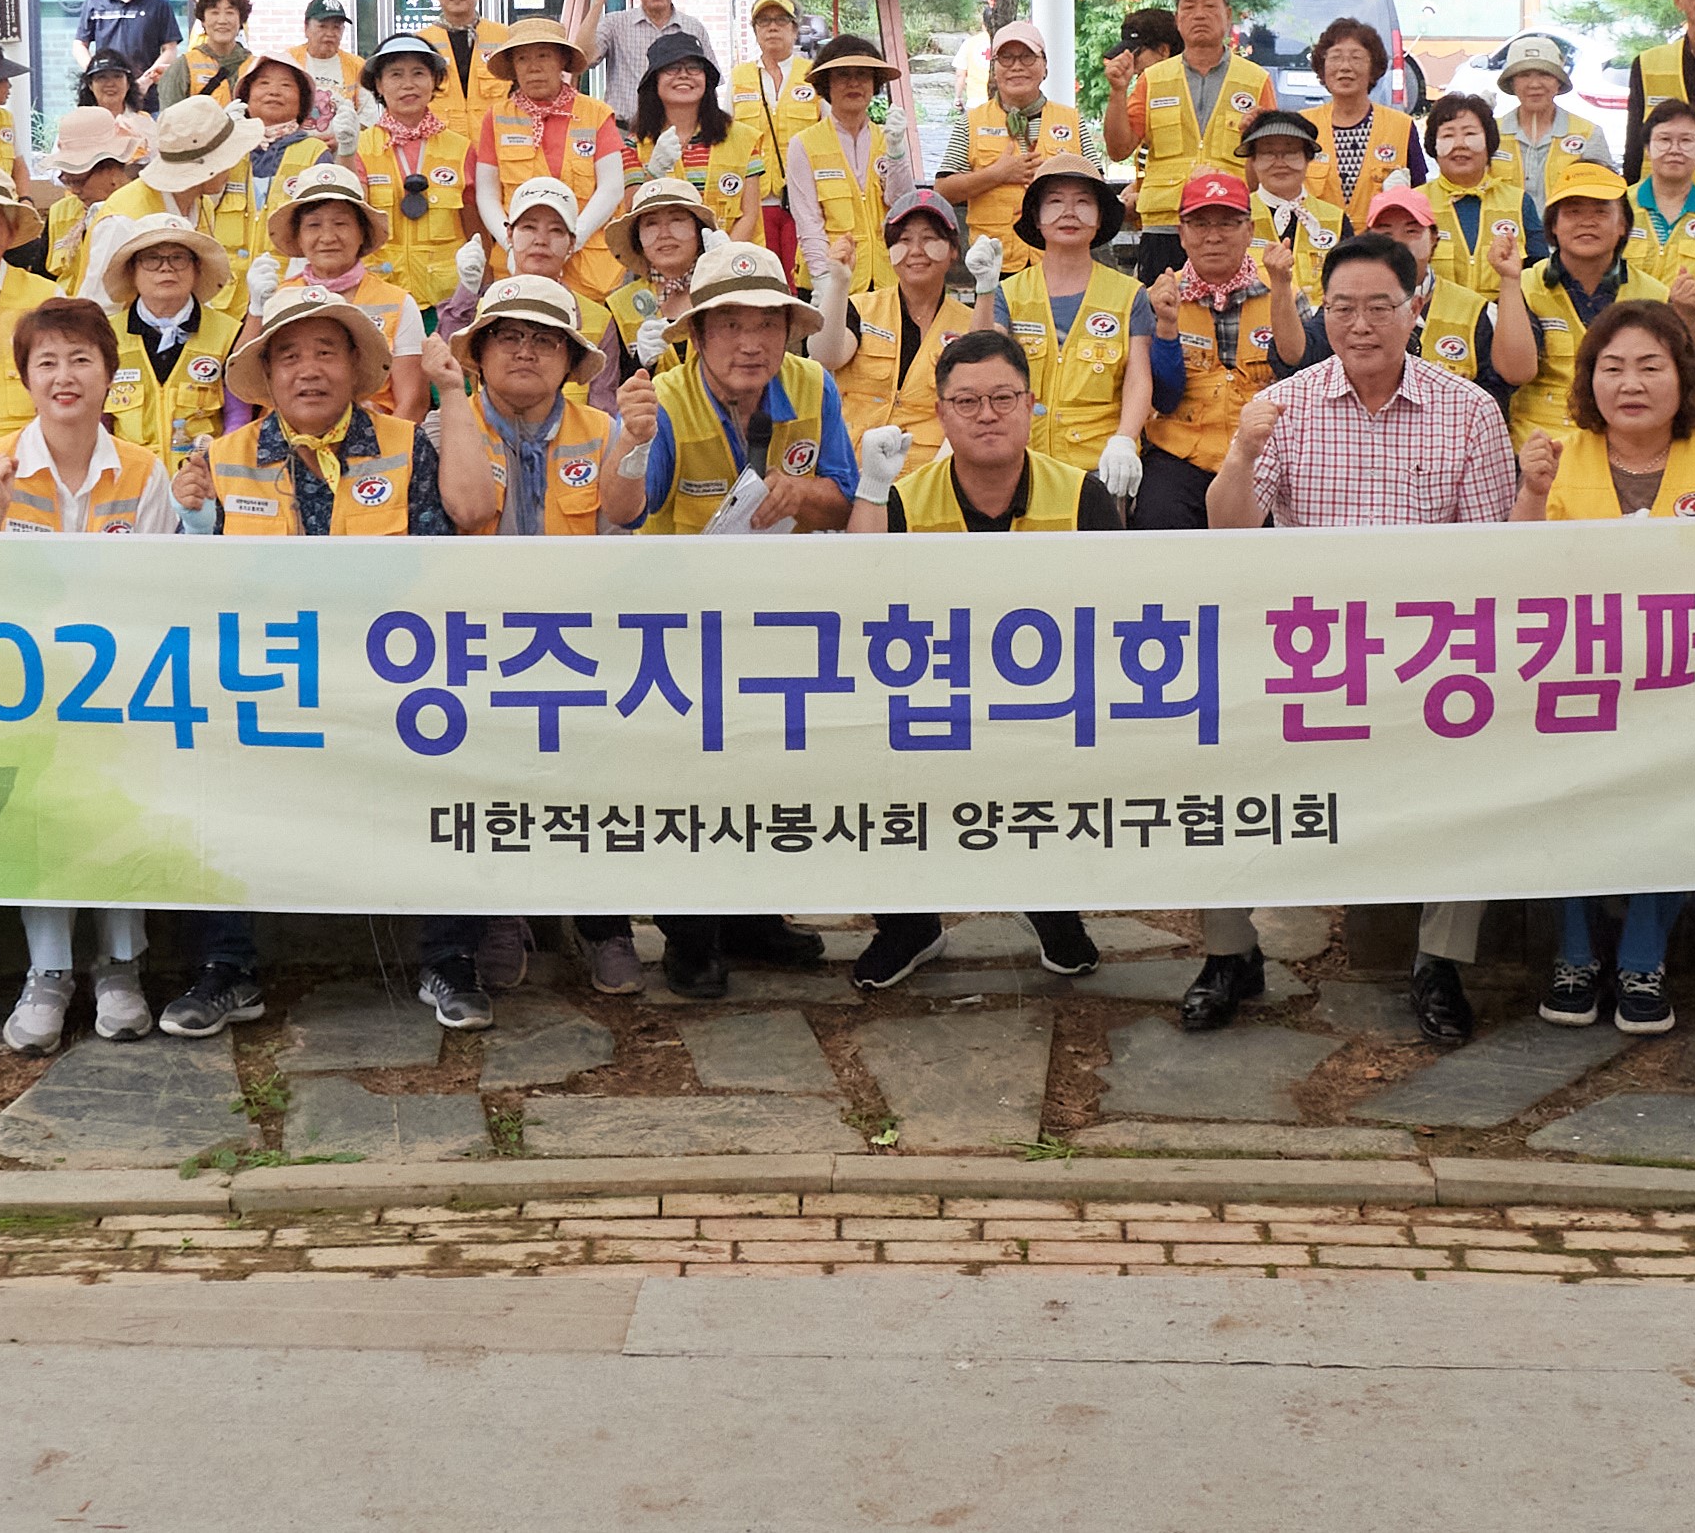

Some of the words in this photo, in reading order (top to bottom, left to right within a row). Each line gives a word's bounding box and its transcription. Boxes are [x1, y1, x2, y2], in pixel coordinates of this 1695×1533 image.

[367, 605, 1218, 755] 양주지구협의회
[431, 798, 929, 853] 대한적십자사봉사회
[953, 793, 1339, 850] 양주지구협의회
